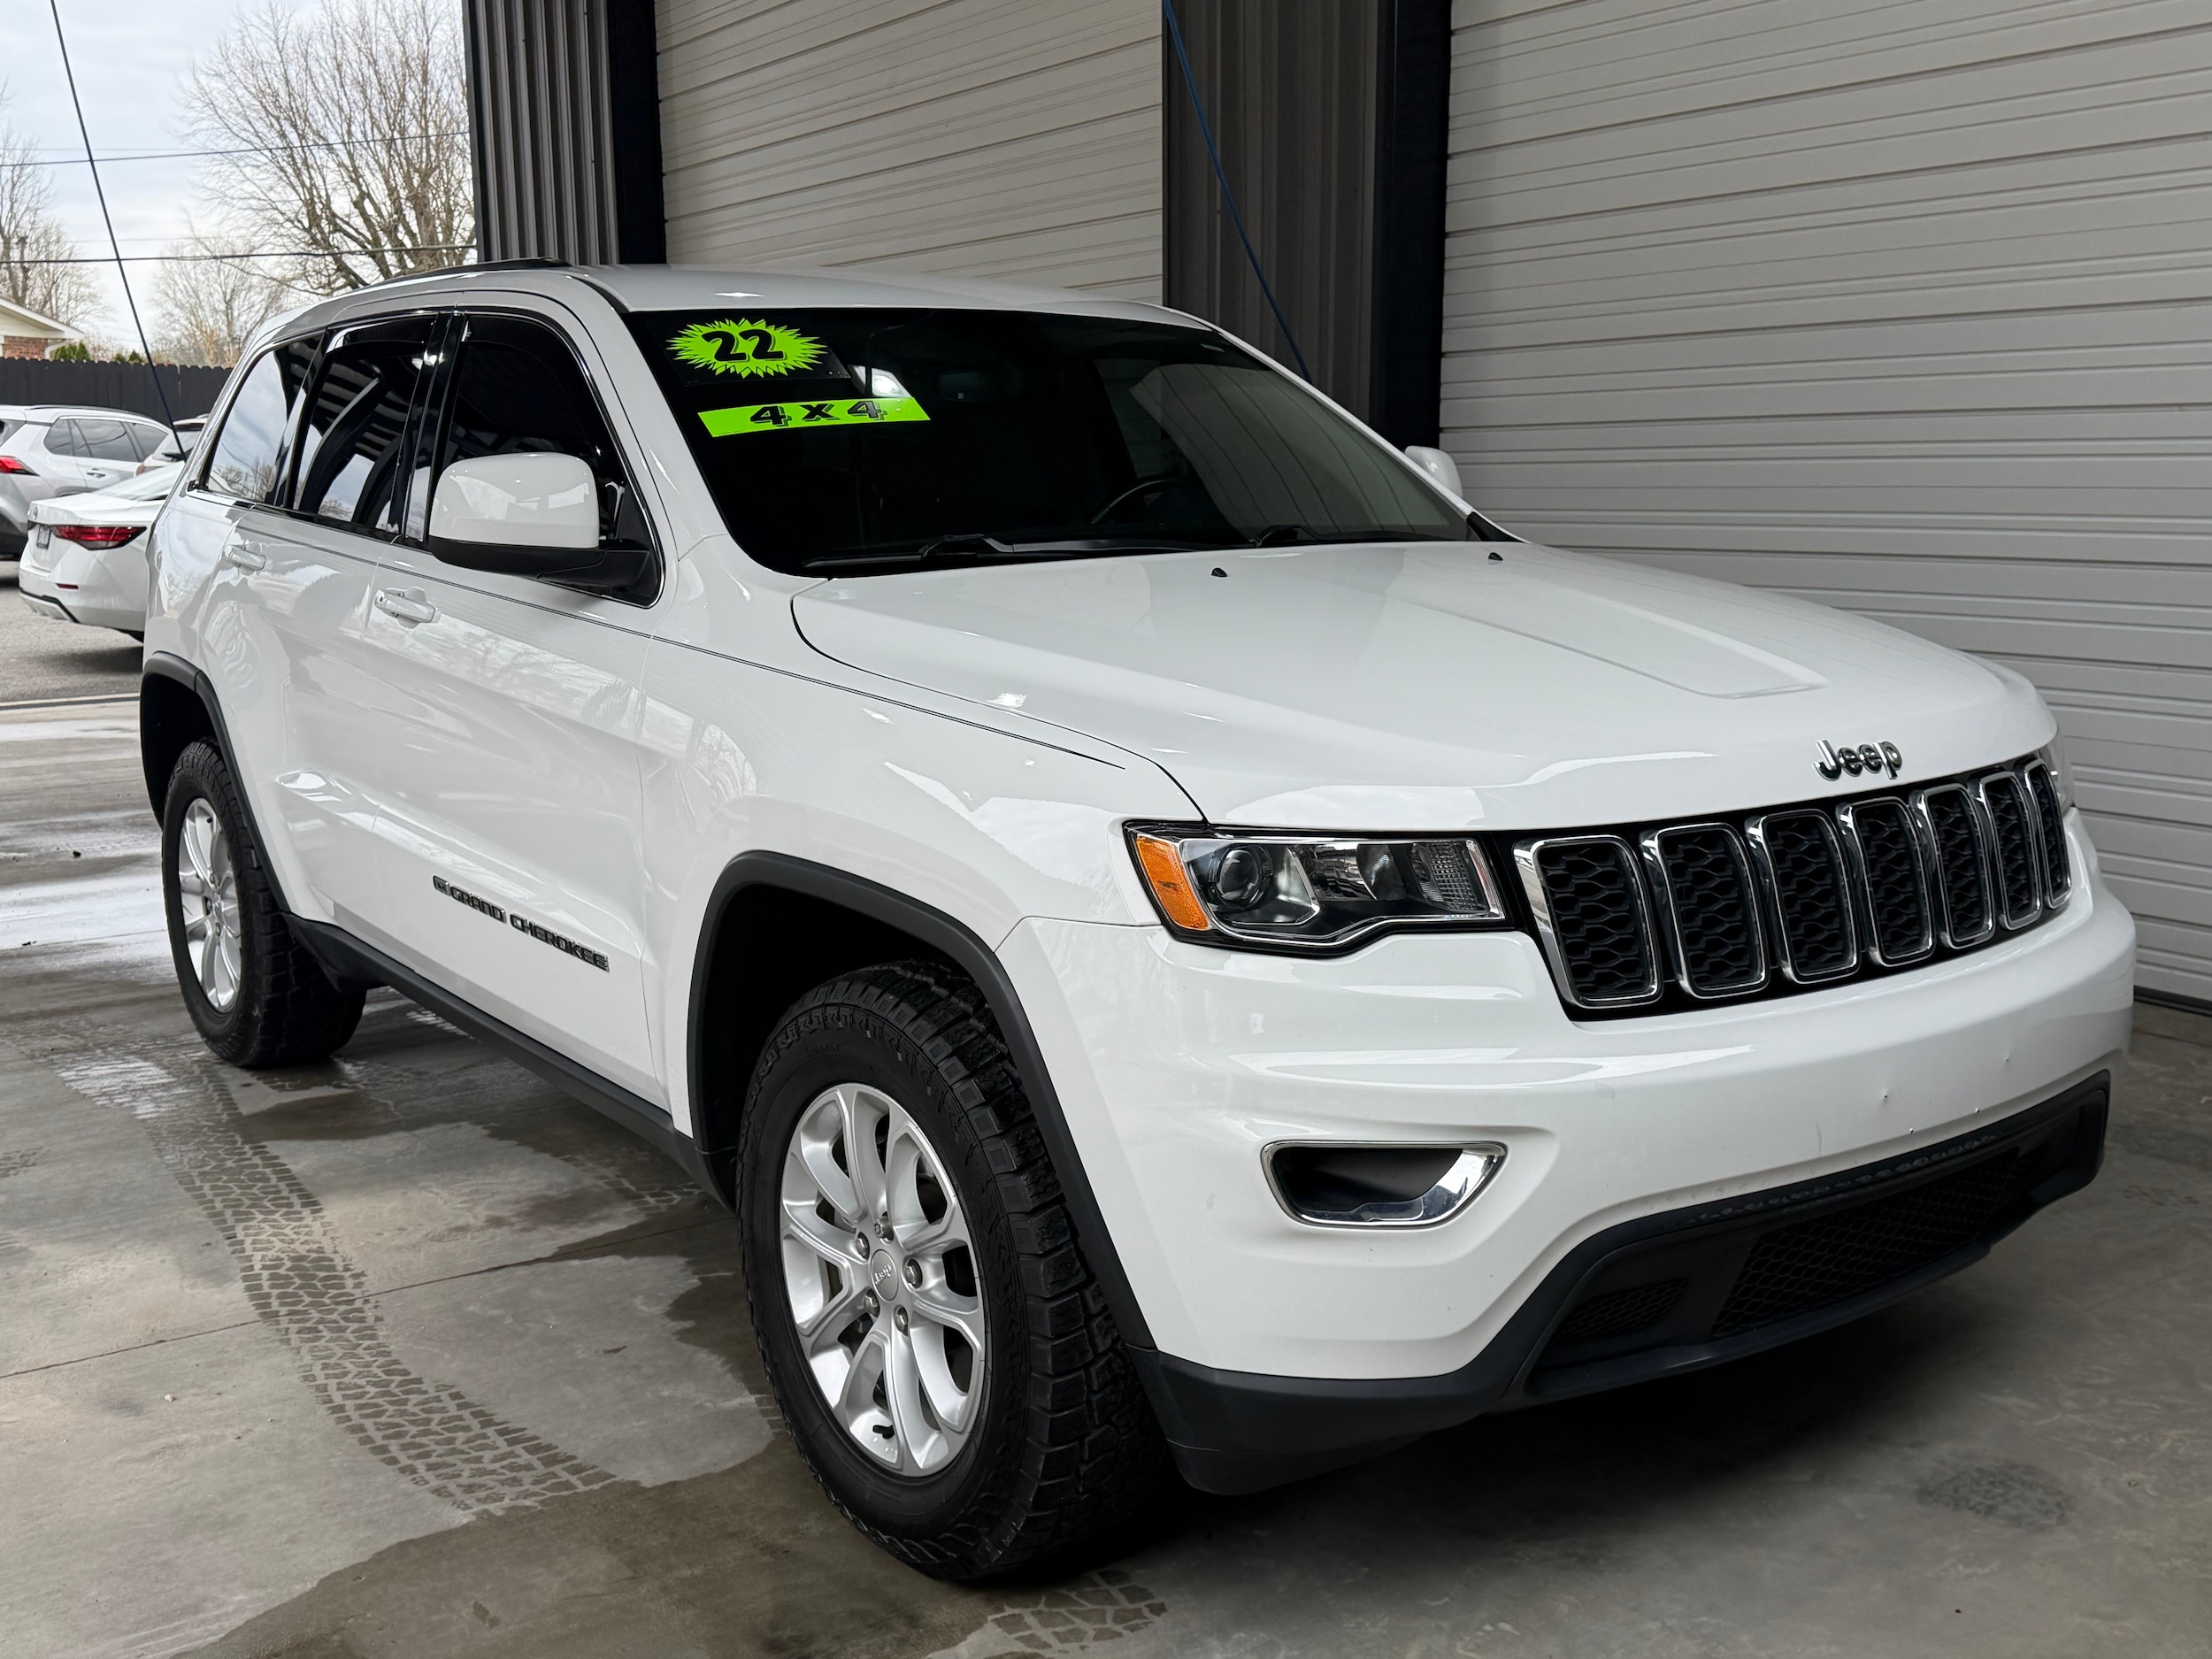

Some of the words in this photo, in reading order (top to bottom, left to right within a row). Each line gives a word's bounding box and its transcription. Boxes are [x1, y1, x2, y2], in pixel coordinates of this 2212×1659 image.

[701, 328, 787, 362] 22
[1812, 739, 1902, 781] Jeep
[450, 886, 507, 924] GRAND
[510, 913, 610, 973] CHEROKEE
